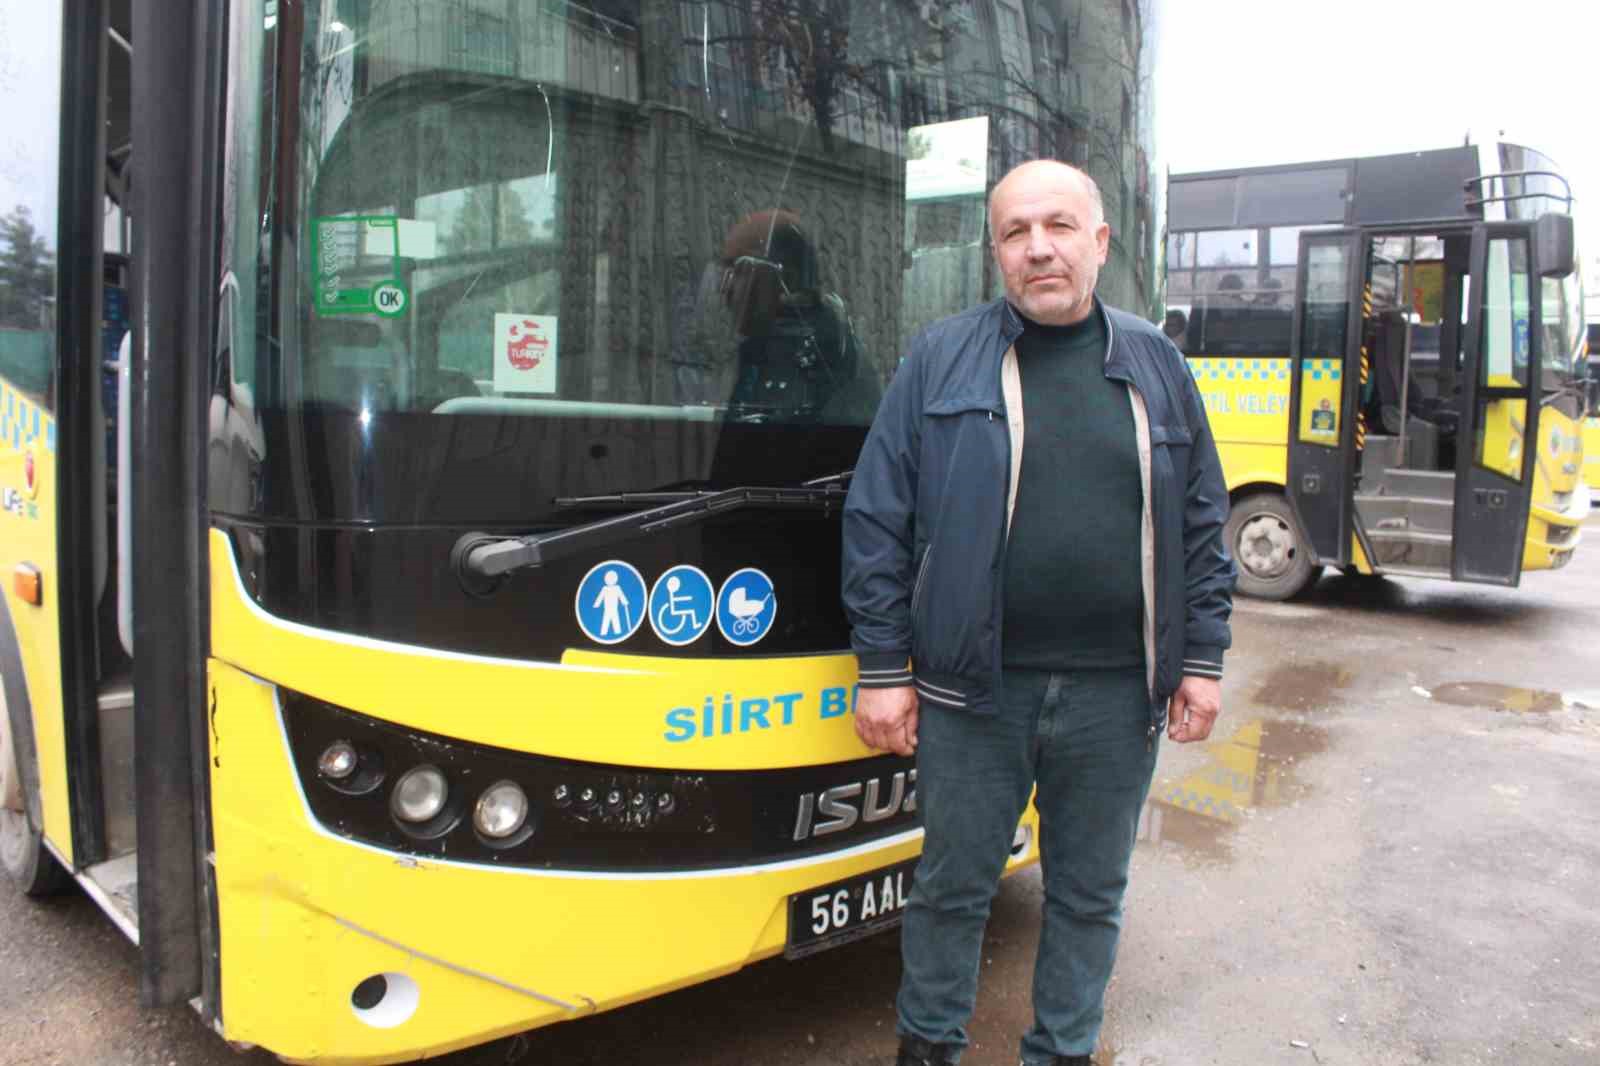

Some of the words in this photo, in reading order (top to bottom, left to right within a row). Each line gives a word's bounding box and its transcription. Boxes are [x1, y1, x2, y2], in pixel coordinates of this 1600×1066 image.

[379, 290, 400, 306] OK
[811, 889, 849, 934] 56
[860, 871, 908, 920] AAL
